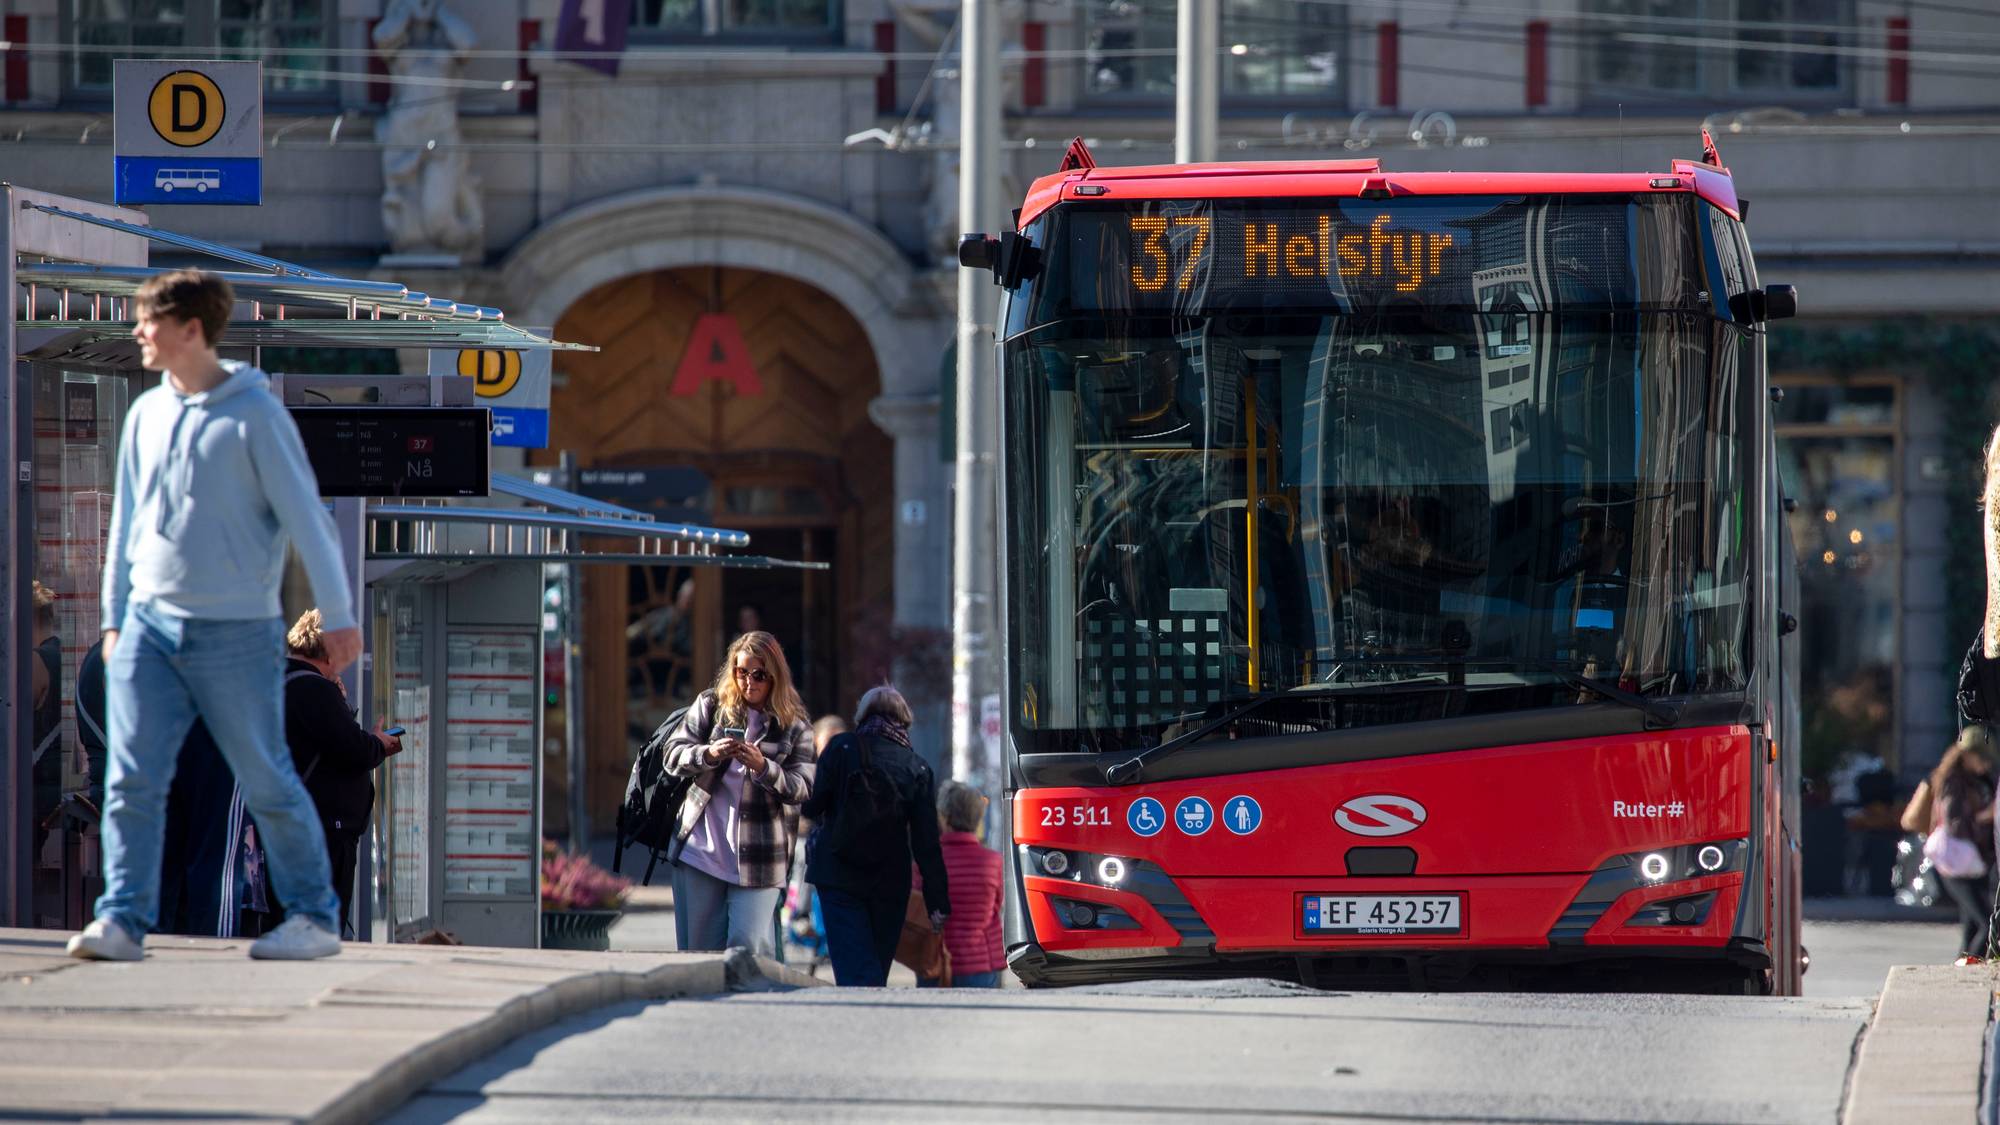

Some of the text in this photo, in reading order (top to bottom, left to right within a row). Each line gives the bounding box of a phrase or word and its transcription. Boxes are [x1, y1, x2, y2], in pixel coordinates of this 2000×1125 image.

[172, 84, 207, 132] D
[1131, 216, 1452, 291] 37 Helsfyr
[670, 313, 763, 397] A
[477, 350, 506, 385] D
[414, 440, 427, 450] 37
[407, 459, 433, 478] Nå
[1041, 806, 1112, 827] 23 511
[1613, 800, 1685, 818] Ruter#
[1329, 901, 1452, 924] EF 45257
